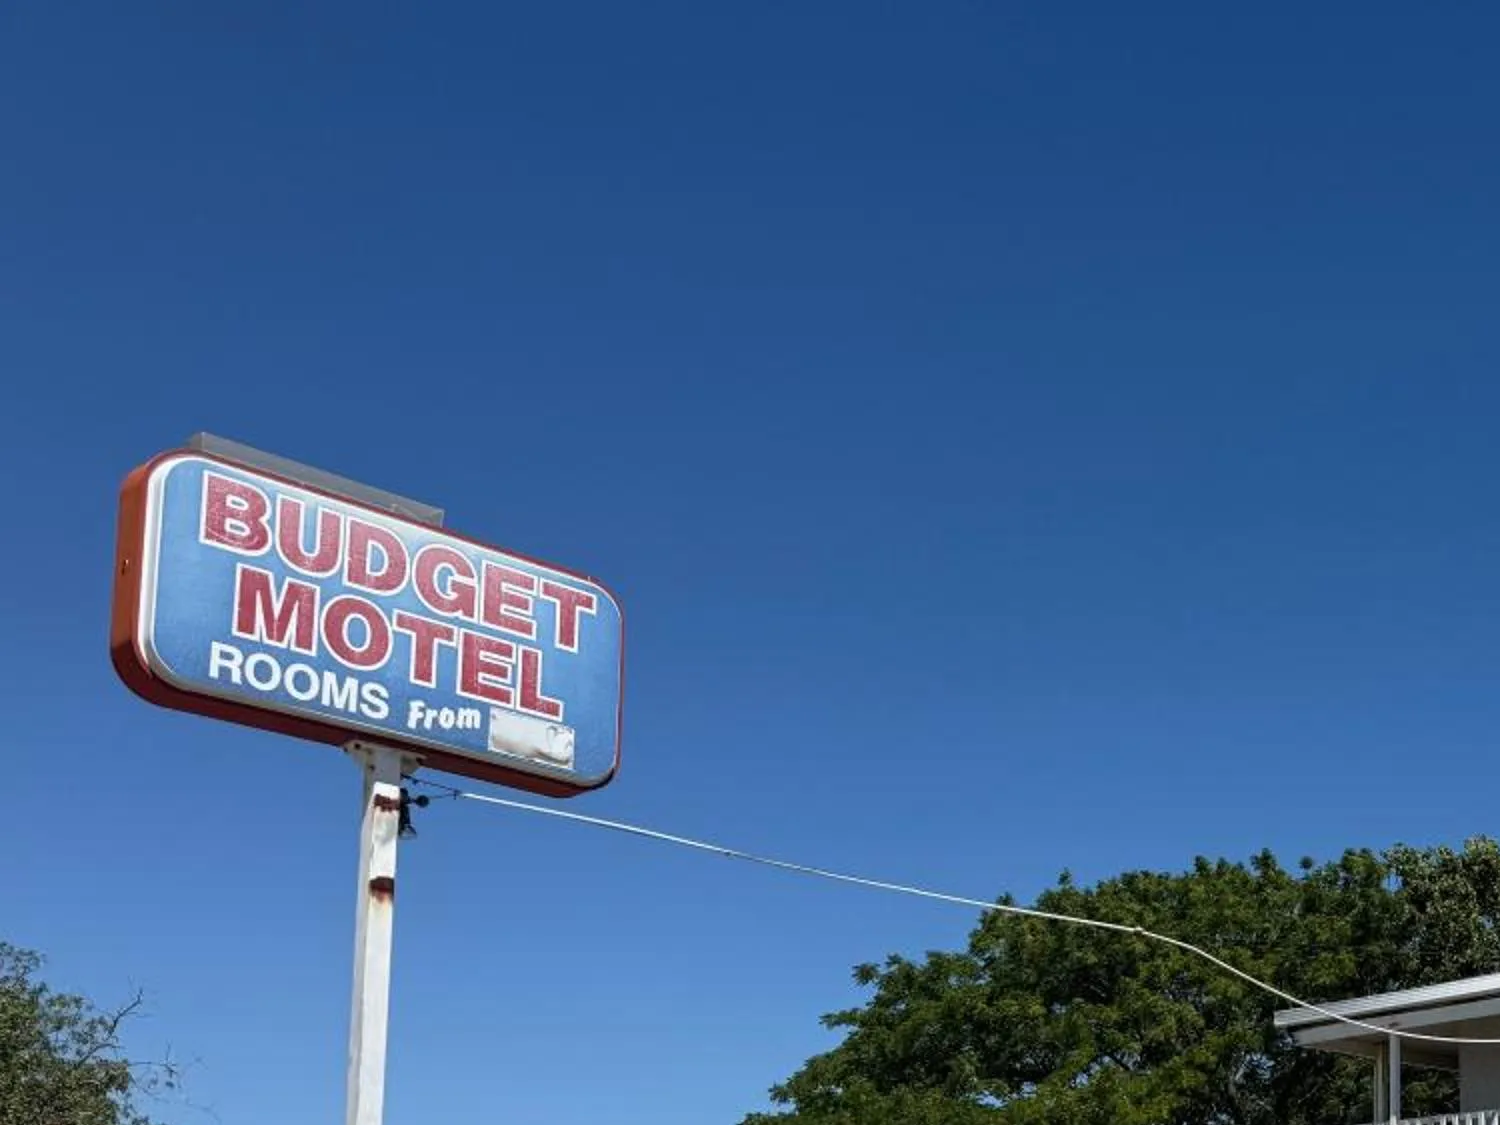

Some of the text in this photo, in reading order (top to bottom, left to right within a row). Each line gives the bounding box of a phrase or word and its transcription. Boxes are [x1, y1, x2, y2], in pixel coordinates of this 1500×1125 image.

[200, 470, 597, 653] BUDGET
[209, 642, 389, 720] ROOMS
[232, 564, 563, 721] MOTEL
